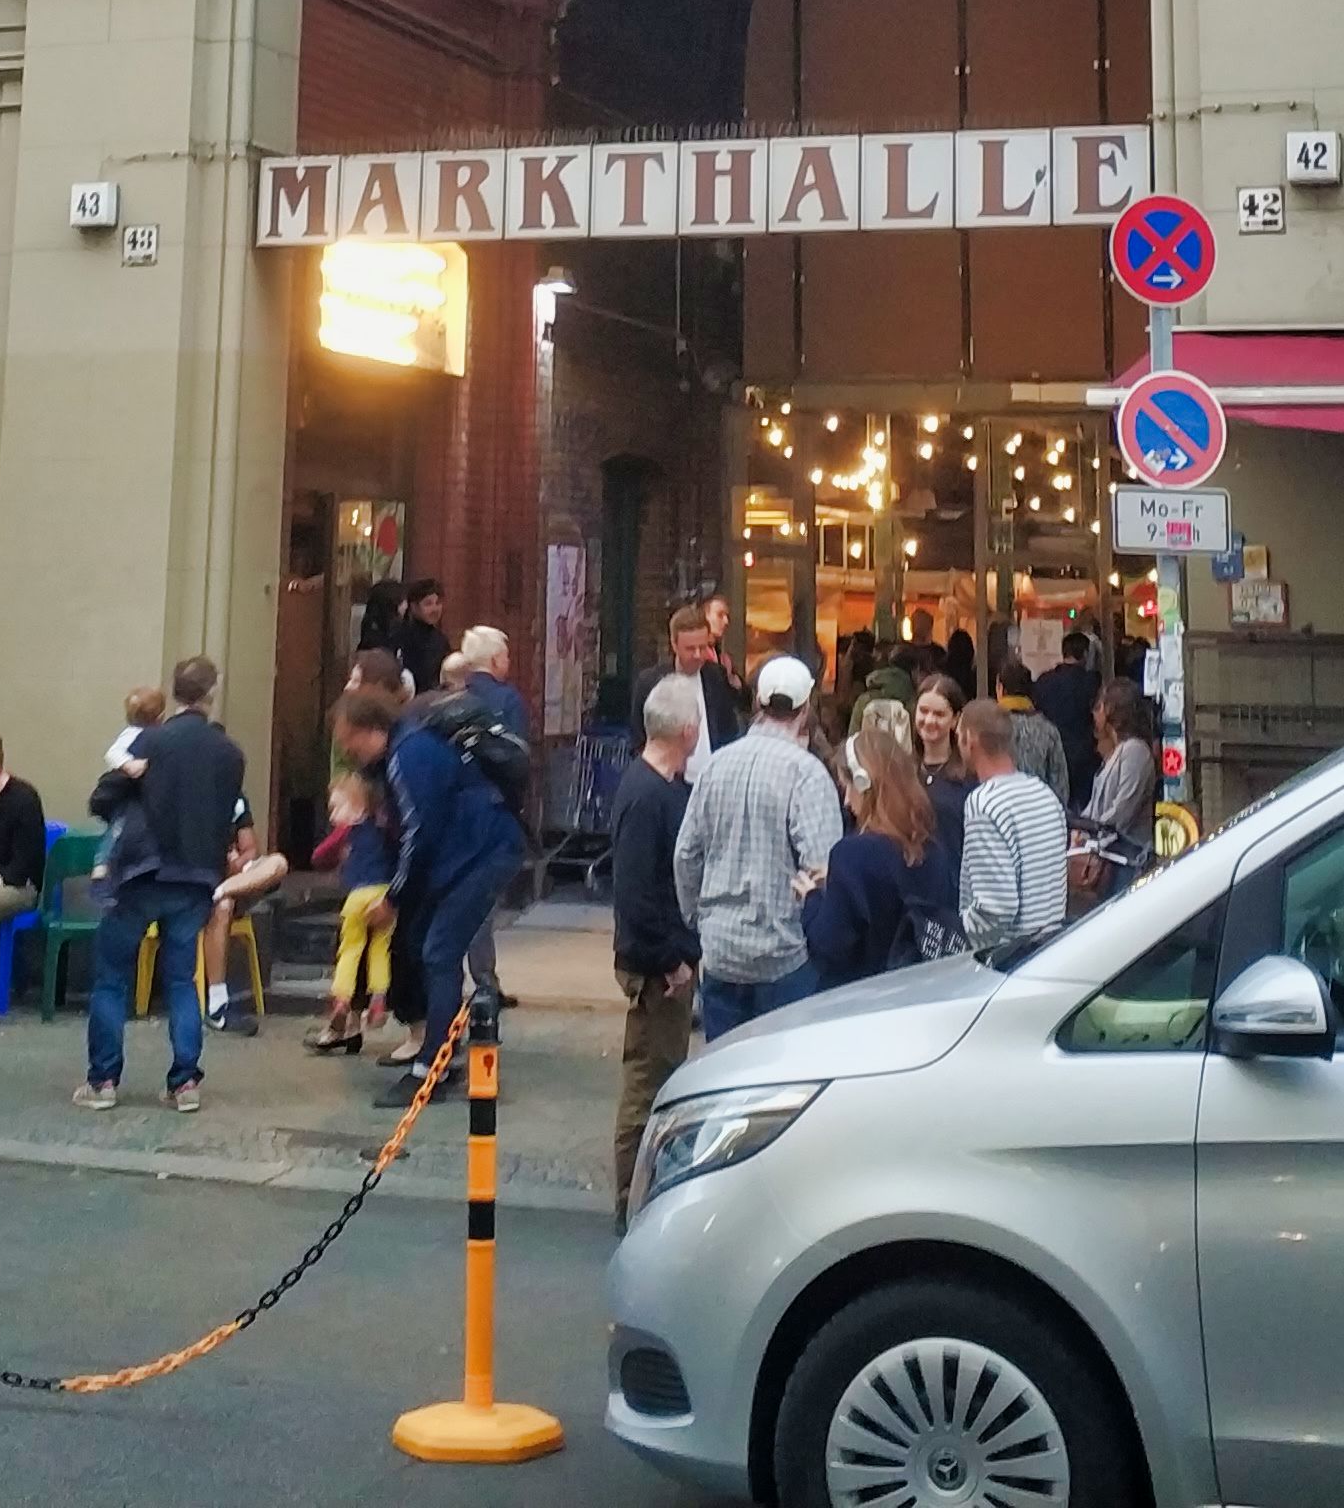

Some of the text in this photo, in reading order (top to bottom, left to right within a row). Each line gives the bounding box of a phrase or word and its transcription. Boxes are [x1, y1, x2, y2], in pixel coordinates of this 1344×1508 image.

[1296, 140, 1328, 171] 42
[265, 134, 1133, 239] MARKTHALLE
[76, 191, 101, 218] 43
[1242, 193, 1281, 217] 42
[1140, 499, 1204, 519] Mo-Fr
